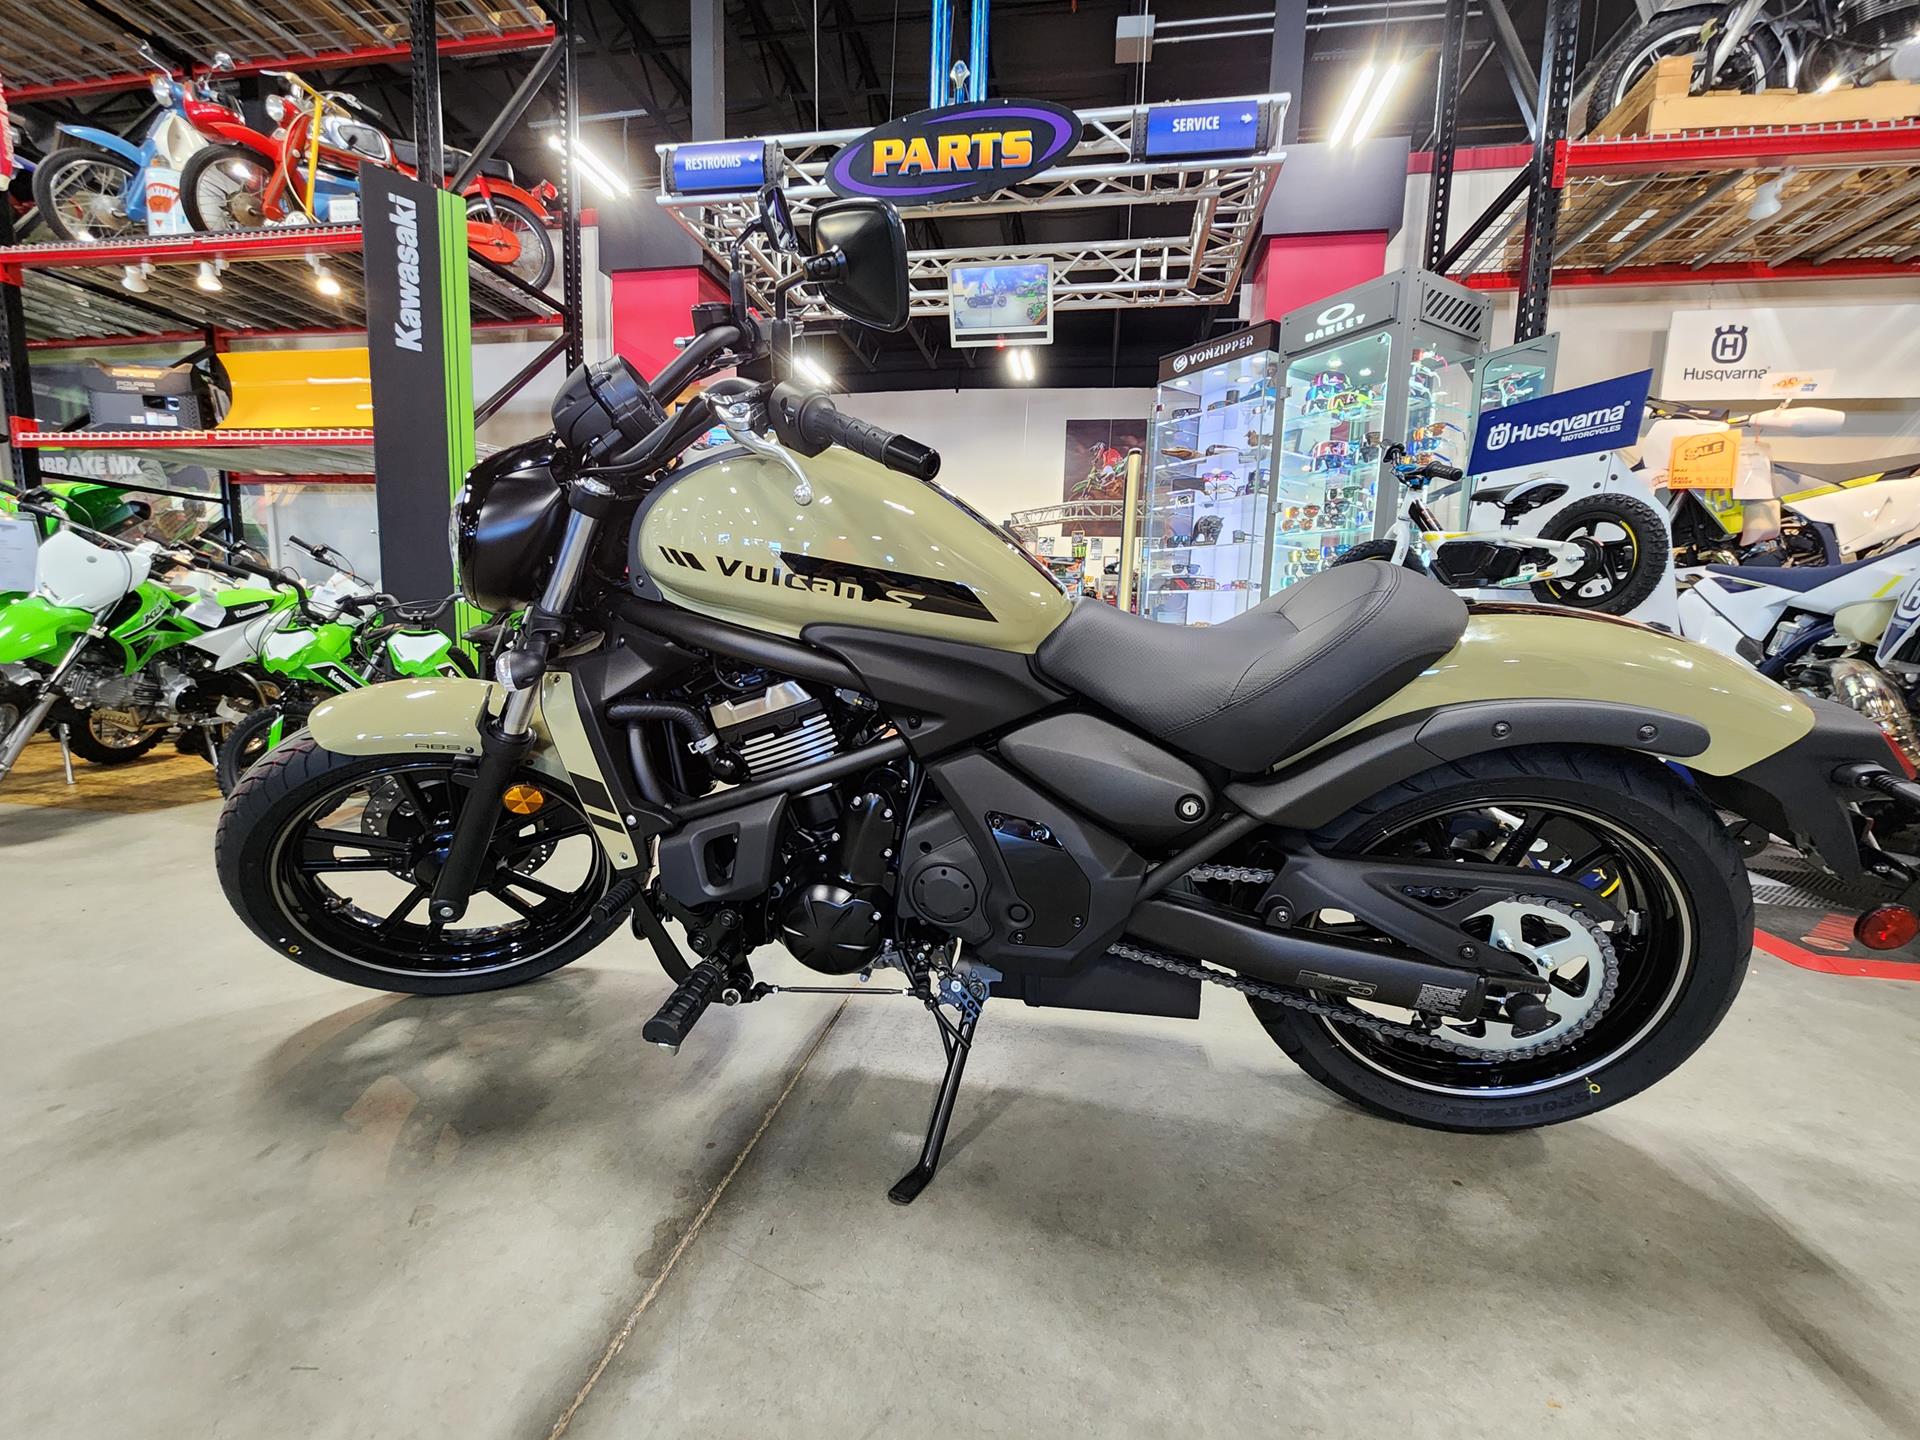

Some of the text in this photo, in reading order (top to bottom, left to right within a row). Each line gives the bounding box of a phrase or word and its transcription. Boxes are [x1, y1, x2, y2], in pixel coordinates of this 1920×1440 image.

[1172, 115, 1220, 133] SERVICE
[685, 154, 742, 171] RESTROOMS
[871, 129, 1034, 178] PARTS
[387, 191, 423, 352] Kawasaki
[1304, 313, 1366, 343] OAKLEY
[1189, 334, 1254, 366] VONZIPPER
[1510, 404, 1626, 445] Husqvarna
[1560, 424, 1622, 443] MOTORCYCLES
[1684, 440, 1725, 461] SALE
[108, 455, 143, 474] MX
[715, 555, 928, 609] Vulcan S
[414, 743, 461, 751] ABS
